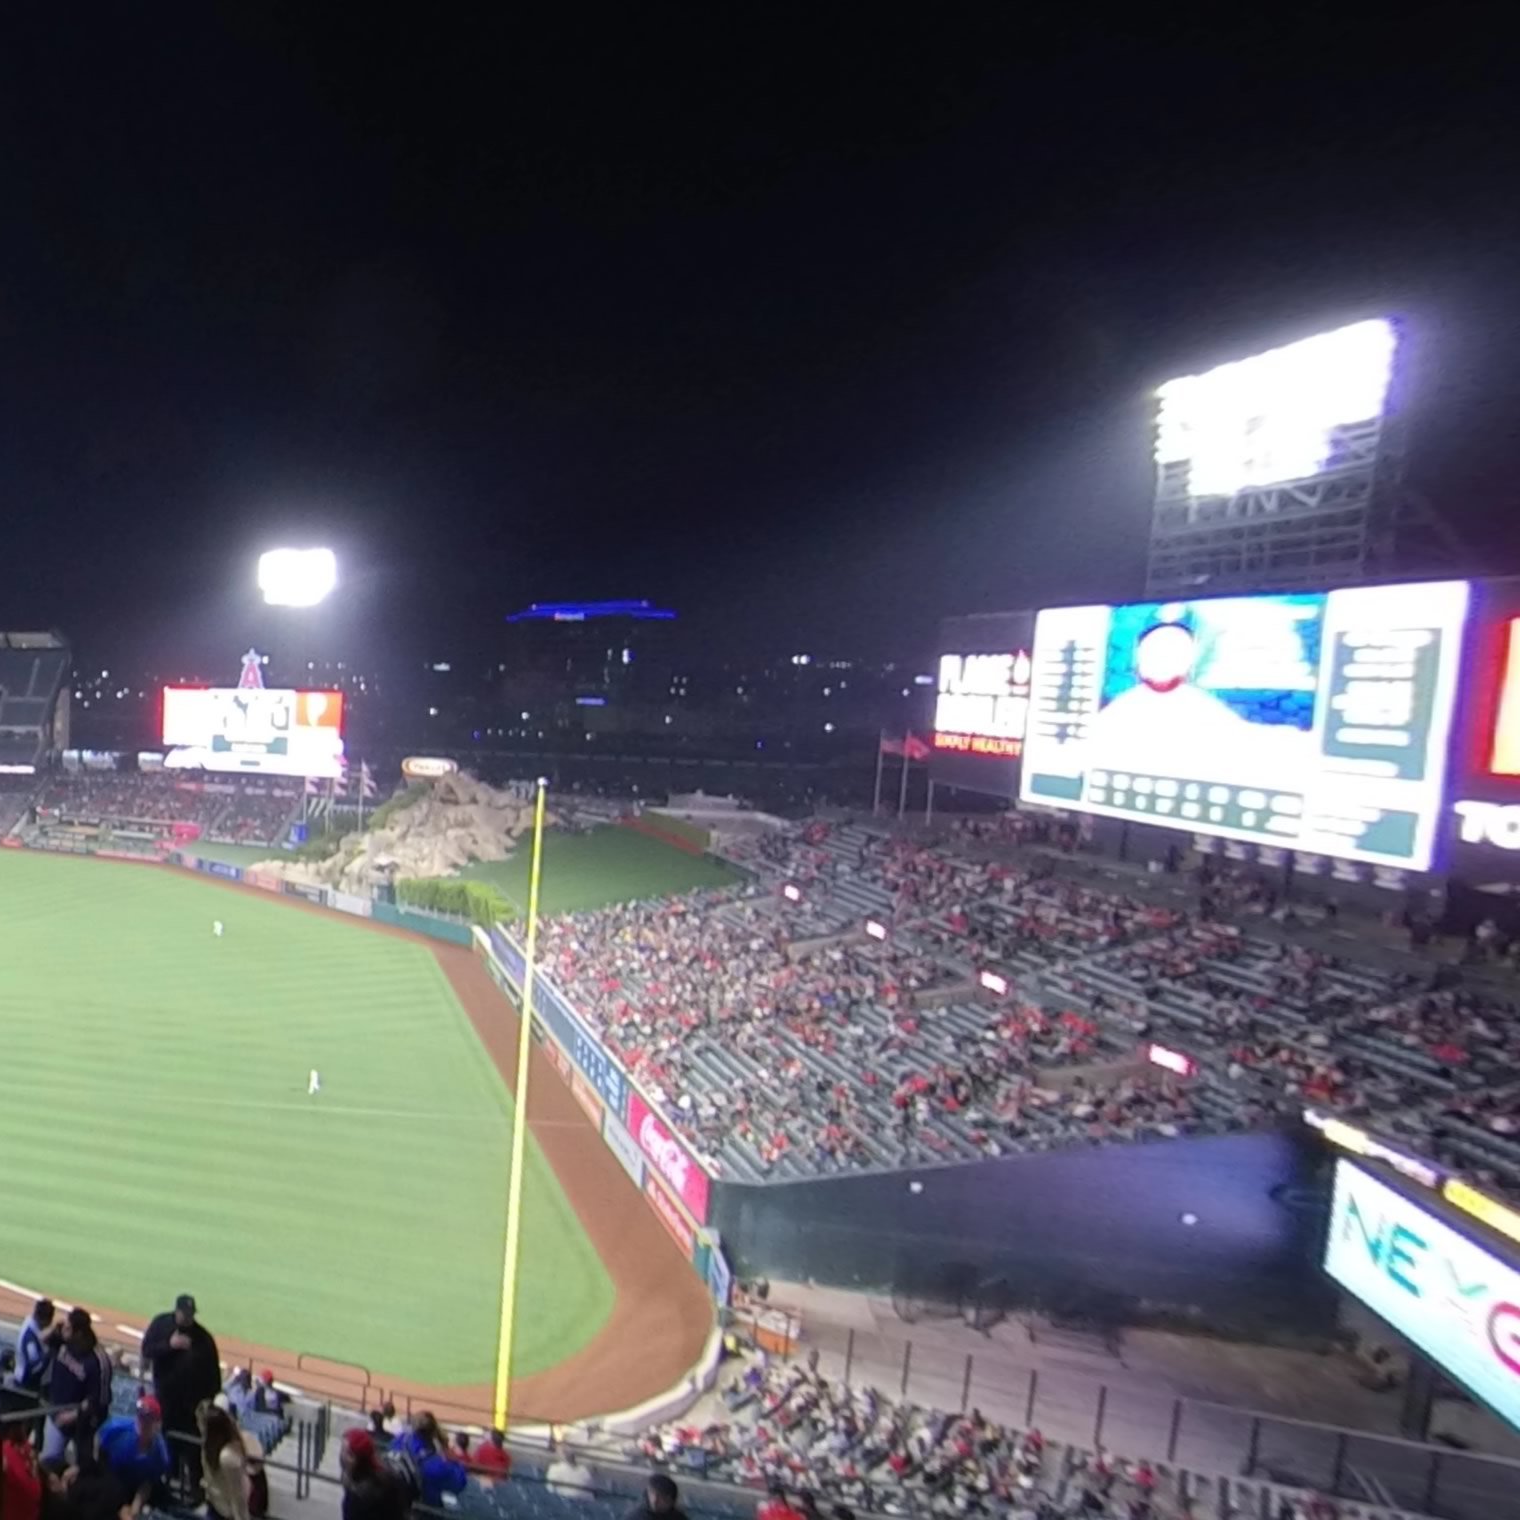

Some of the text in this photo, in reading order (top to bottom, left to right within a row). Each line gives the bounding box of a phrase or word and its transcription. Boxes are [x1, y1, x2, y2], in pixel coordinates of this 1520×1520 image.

[939, 653, 1013, 695] FLAME
[934, 732, 1022, 757] SIMPLY HEALTHY
